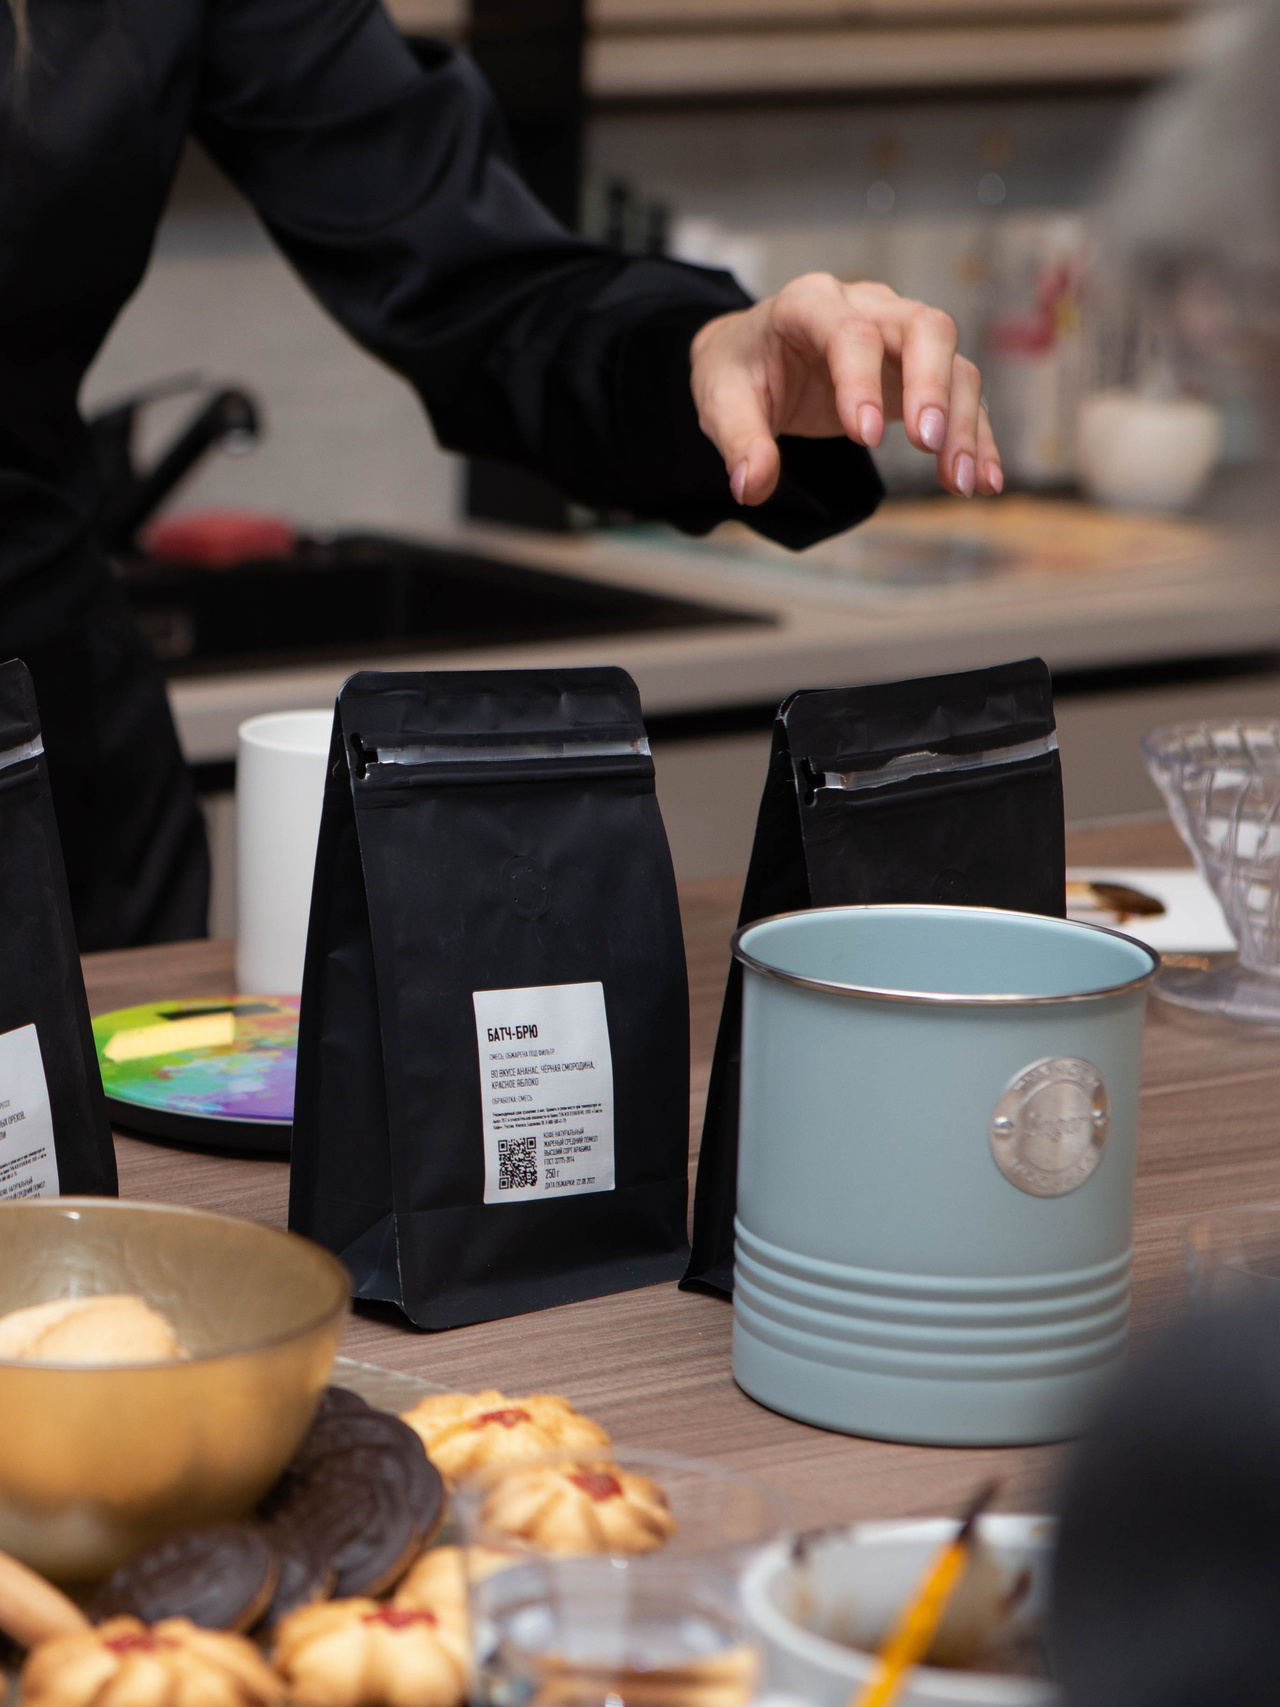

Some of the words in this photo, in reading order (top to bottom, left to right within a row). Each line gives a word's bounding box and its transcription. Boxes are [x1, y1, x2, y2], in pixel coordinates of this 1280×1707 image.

[487, 1024, 538, 1042] БАТЧ-БРЮ
[529, 1050, 538, 1058] ПОД
[490, 1069, 498, 1079] ВО
[499, 1067, 516, 1078] ВКУСЕ
[516, 1065, 540, 1076] АНАНАС,
[491, 1079, 516, 1090] КРАСНОЕ
[516, 1077, 539, 1088] ЯБЛОКО
[545, 1168, 556, 1179] 250
